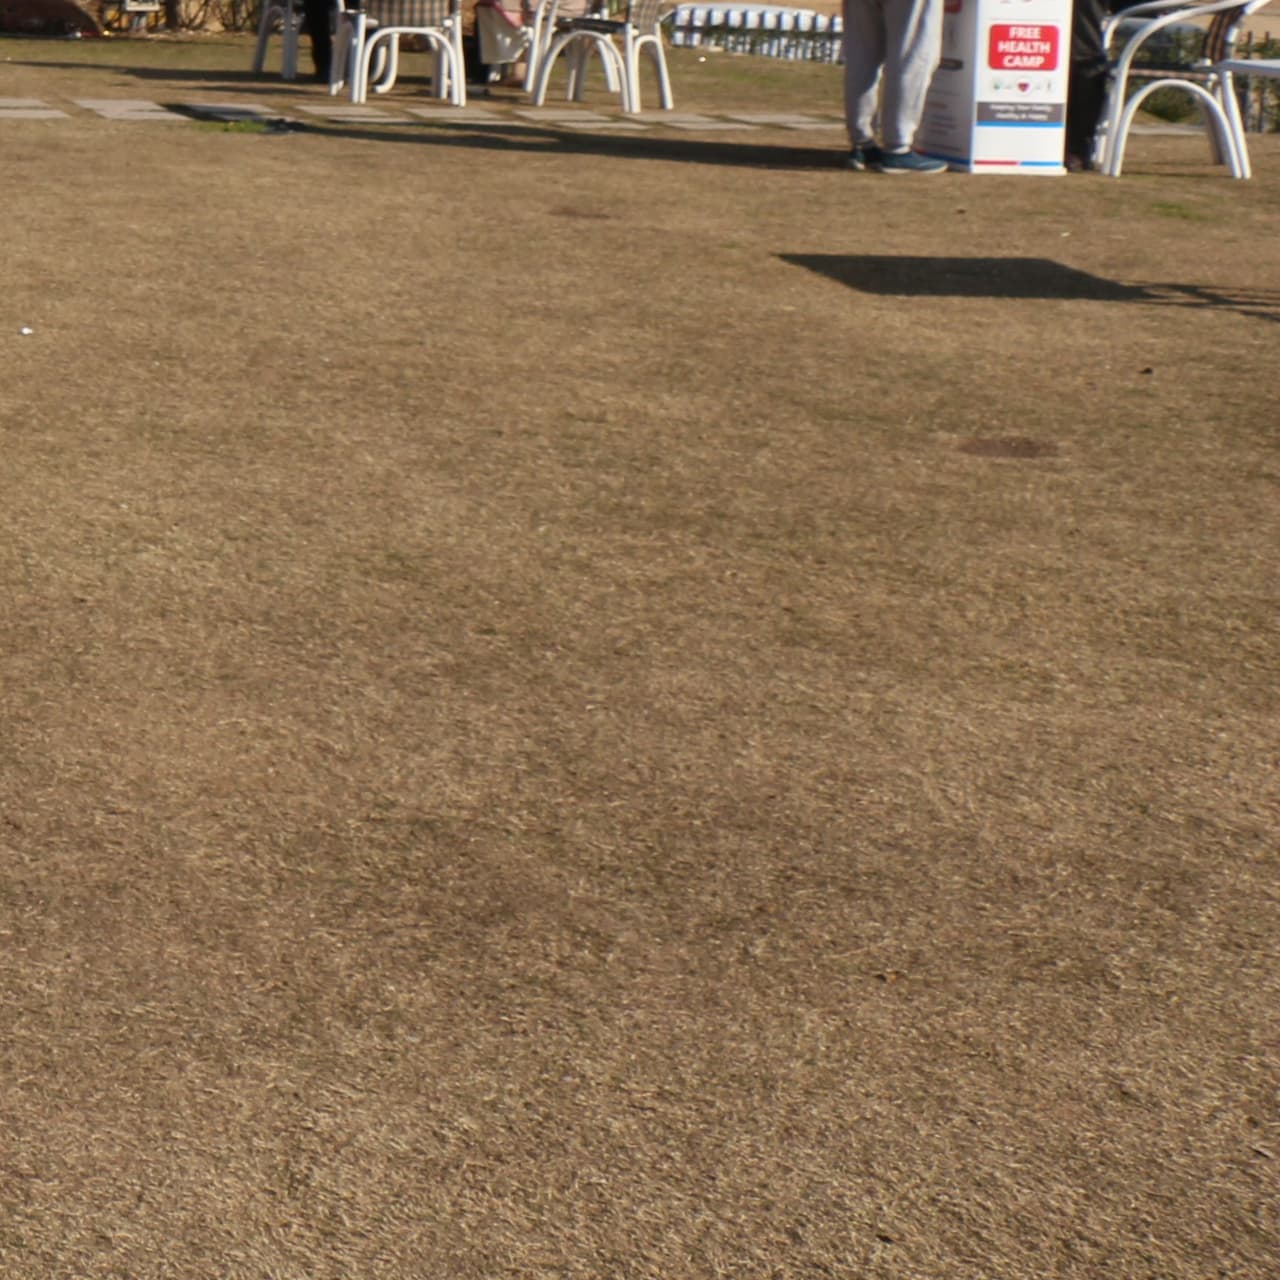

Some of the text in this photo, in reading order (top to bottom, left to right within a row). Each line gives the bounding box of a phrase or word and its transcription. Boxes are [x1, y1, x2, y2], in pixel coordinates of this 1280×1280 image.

[1008, 26, 1042, 40] FREE
[997, 40, 1052, 54] HEALTH
[1002, 54, 1046, 69] CAMP
